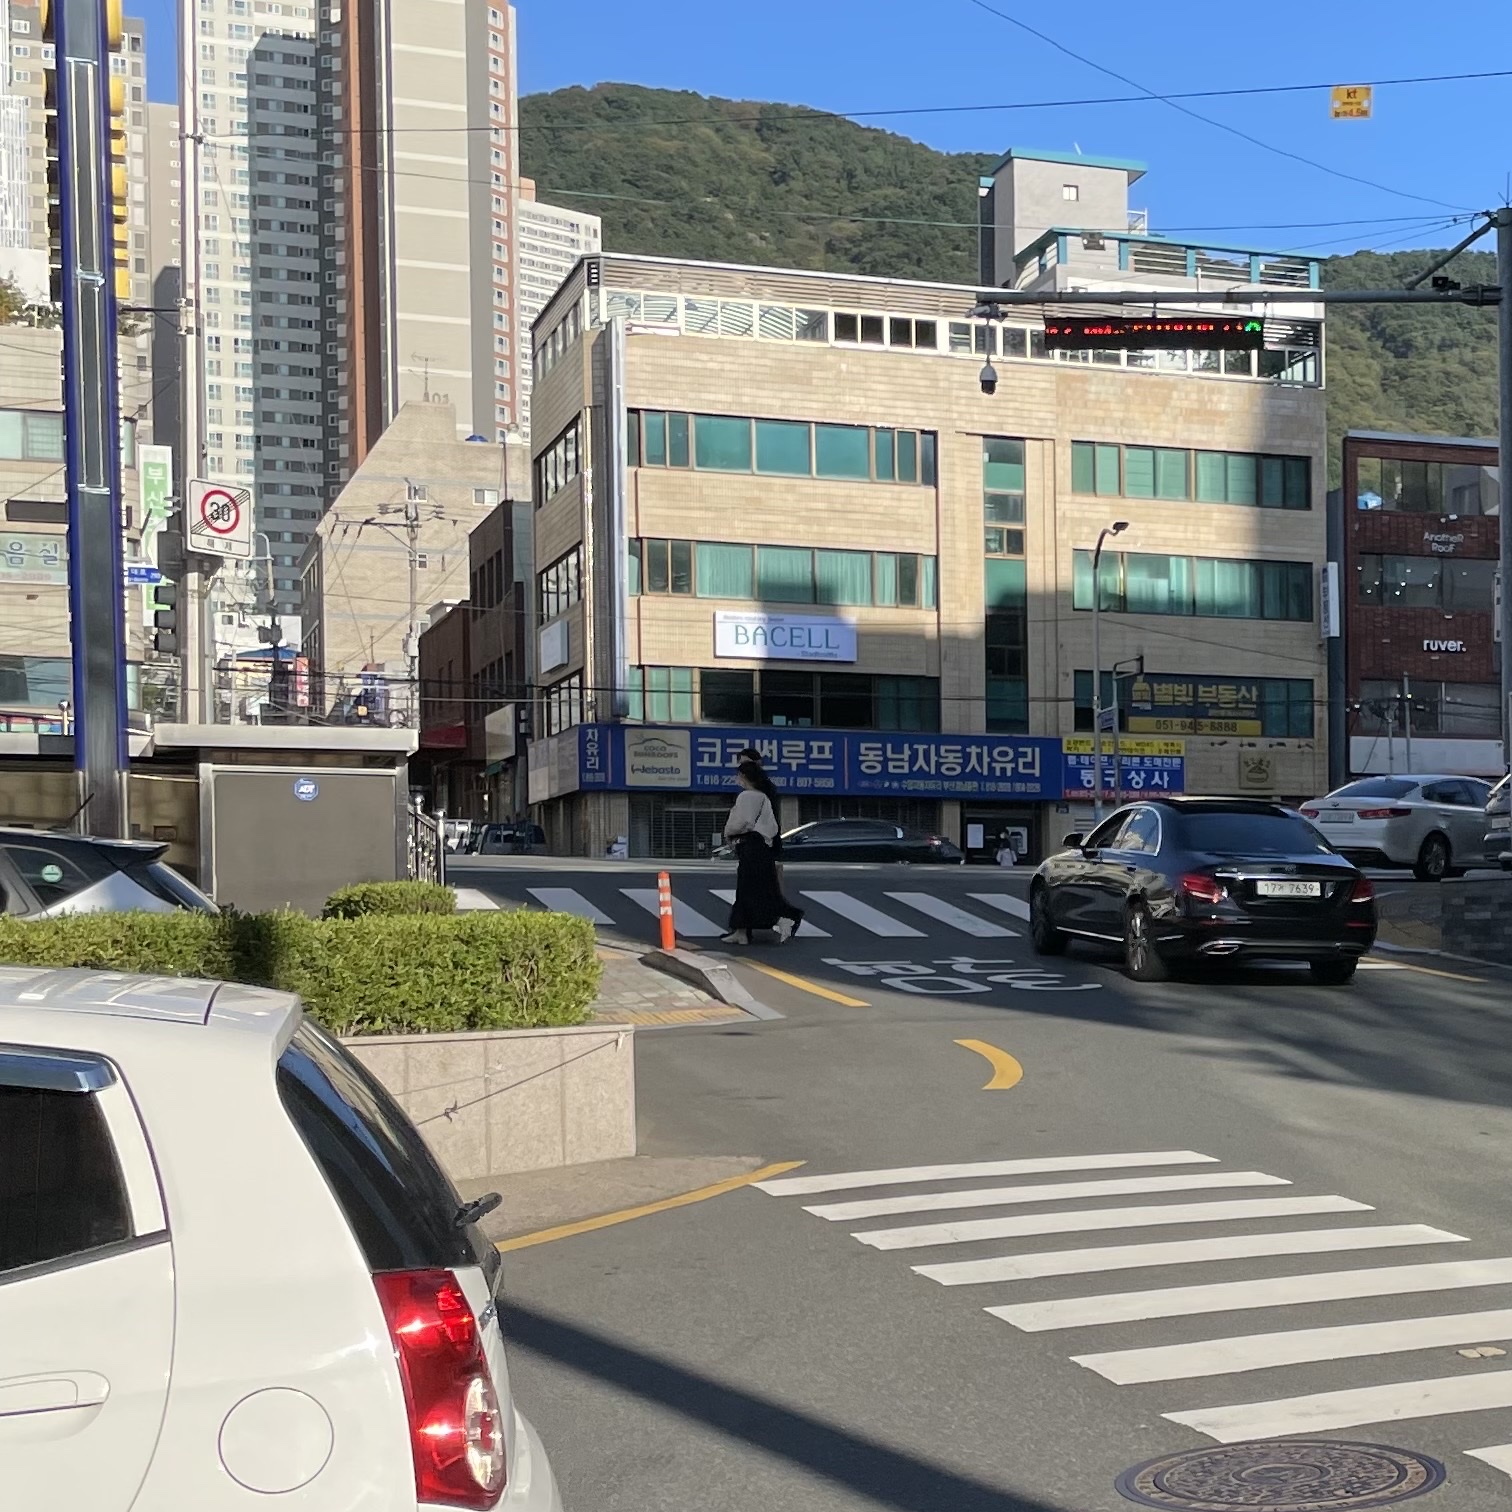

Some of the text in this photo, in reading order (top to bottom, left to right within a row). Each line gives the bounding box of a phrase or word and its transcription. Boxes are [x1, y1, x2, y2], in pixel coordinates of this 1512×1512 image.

[210, 501, 230, 522] 30
[734, 624, 840, 650] BACELL
[1423, 639, 1467, 652] ruver.
[1152, 682, 1259, 709] 별빛 부동산
[696, 737, 834, 772] 코코썬루프
[858, 742, 1041, 778] 동남자동차유리
[1080, 769, 1170, 790] 동구상사
